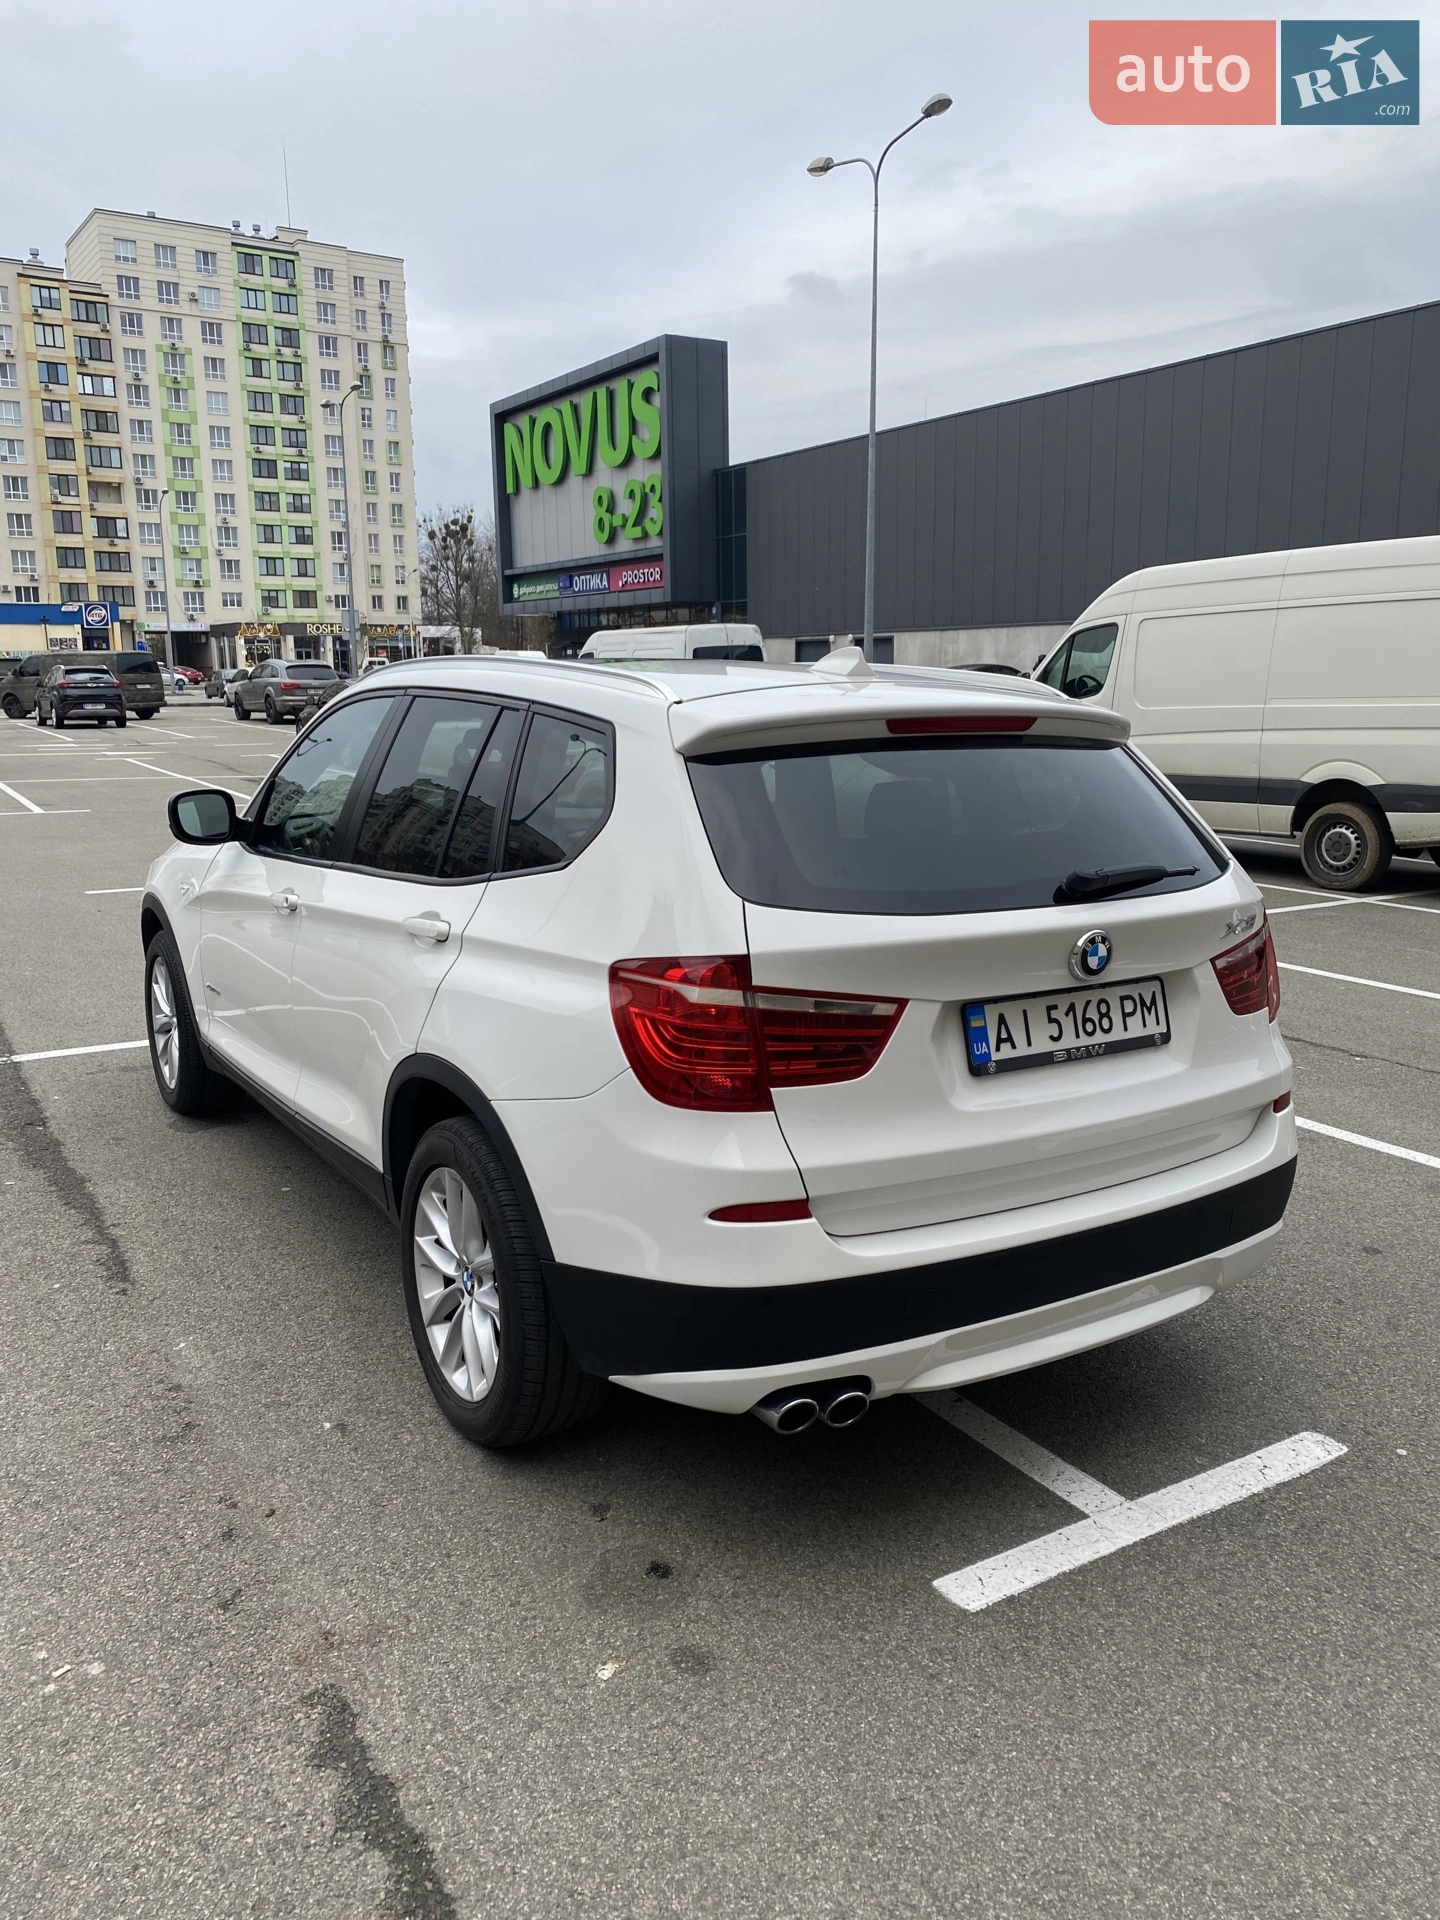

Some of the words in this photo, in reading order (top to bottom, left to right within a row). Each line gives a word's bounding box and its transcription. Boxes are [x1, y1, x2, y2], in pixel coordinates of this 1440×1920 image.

[503, 370, 662, 494] NOVUS
[592, 473, 663, 544] 8-23
[573, 572, 608, 592] ОПТИКА
[1084, 935, 1111, 952] BMW
[994, 1009, 1033, 1053] AI
[1046, 997, 1113, 1043] 5168
[1119, 990, 1160, 1032] PM
[973, 1042, 989, 1055] UA
[1052, 1044, 1106, 1062] BMW
